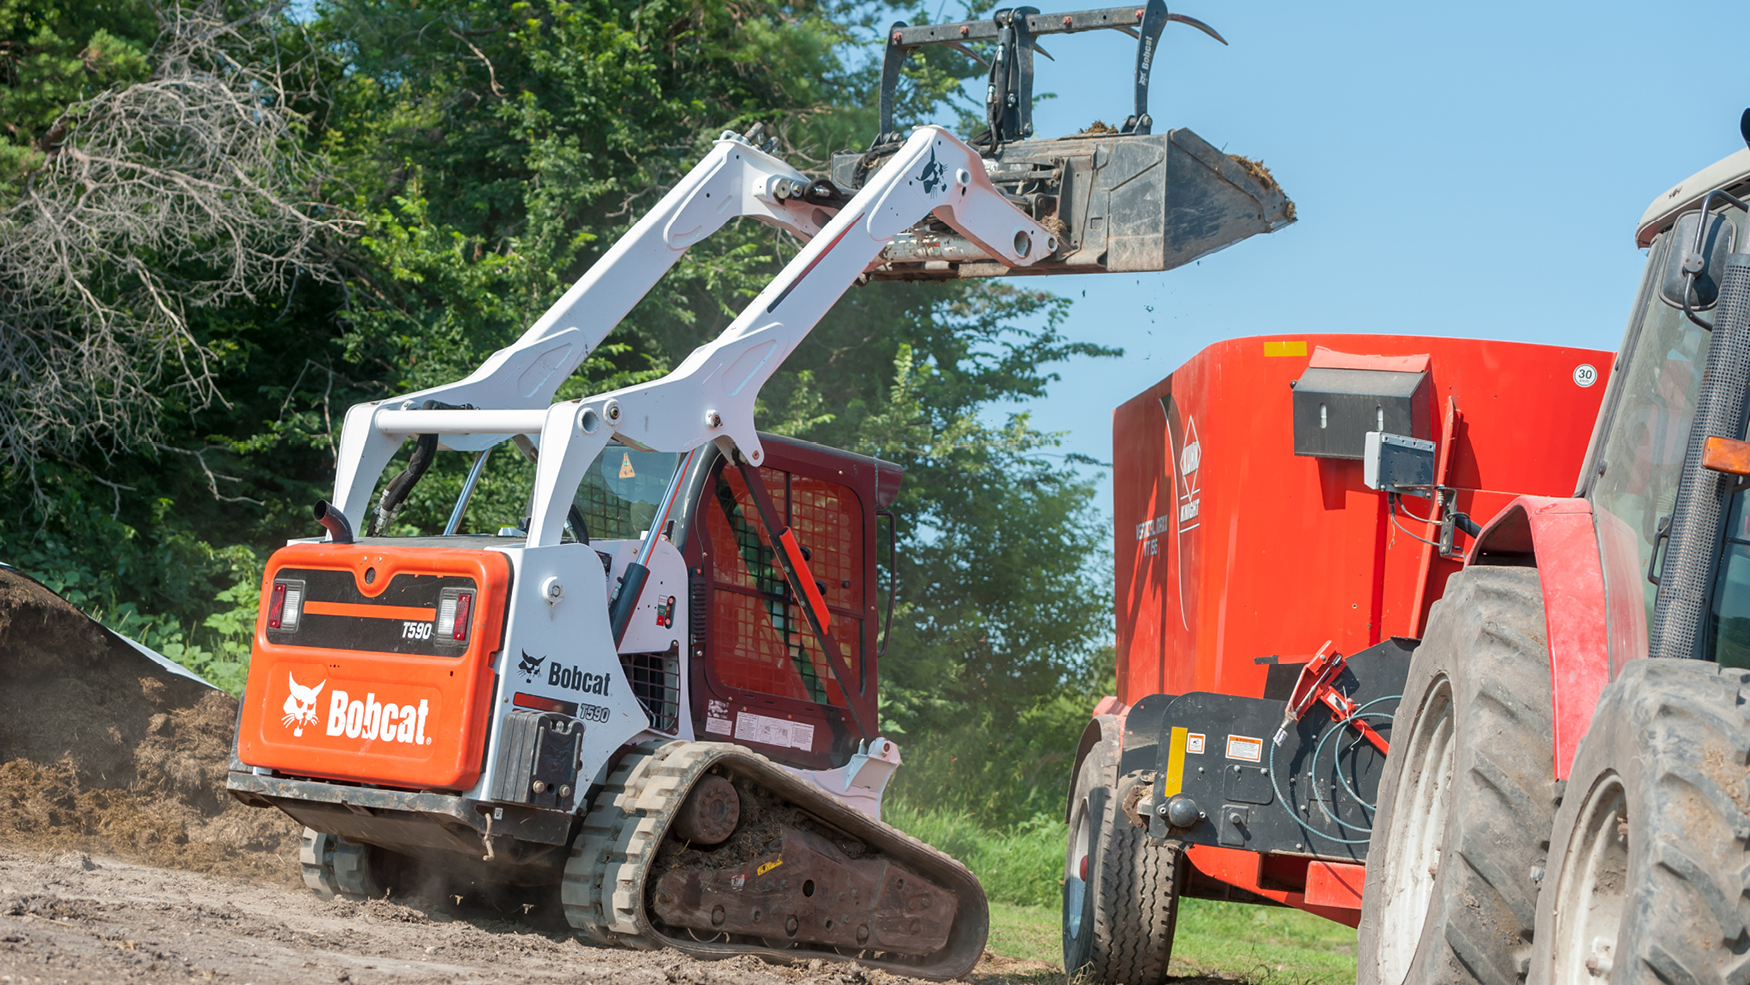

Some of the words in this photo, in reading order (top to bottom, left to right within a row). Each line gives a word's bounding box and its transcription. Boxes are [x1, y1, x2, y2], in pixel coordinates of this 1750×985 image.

[1141, 35, 1153, 70] Bobcat
[1578, 369, 1592, 379] 30
[402, 622, 432, 640] T590
[548, 661, 611, 697] Bobcat
[326, 690, 429, 745] Bobcat
[580, 703, 611, 724] T590
